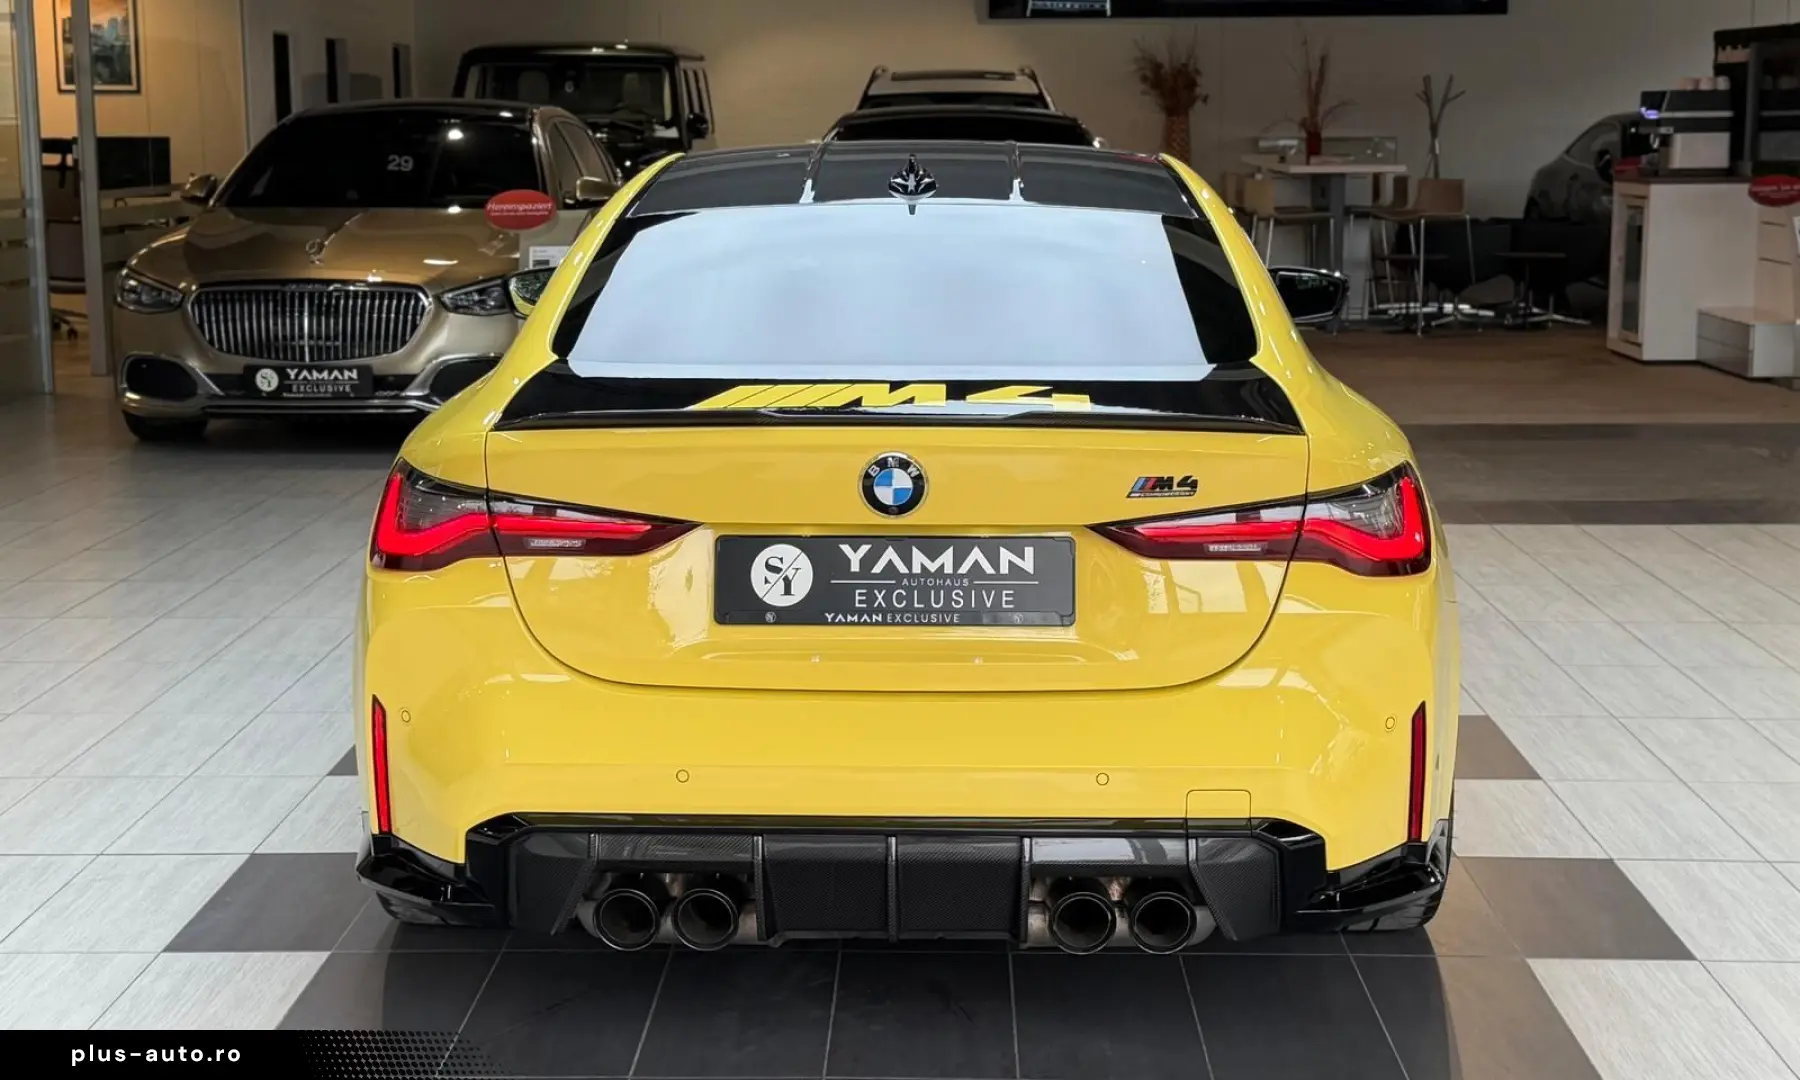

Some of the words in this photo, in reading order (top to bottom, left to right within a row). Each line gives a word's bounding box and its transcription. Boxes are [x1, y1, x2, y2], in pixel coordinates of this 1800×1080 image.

[387, 154, 414, 171] 29
[286, 368, 358, 380] YAMAN
[292, 384, 352, 393] EXCLUSIVE
[867, 456, 921, 478] BMW
[838, 544, 1035, 575] YAMAN
[901, 578, 969, 587] AUTOHAUS
[854, 589, 1015, 609] EXCLUSIVE
[824, 612, 883, 623] YAMAN
[886, 612, 961, 623] EXCLUSIVE
